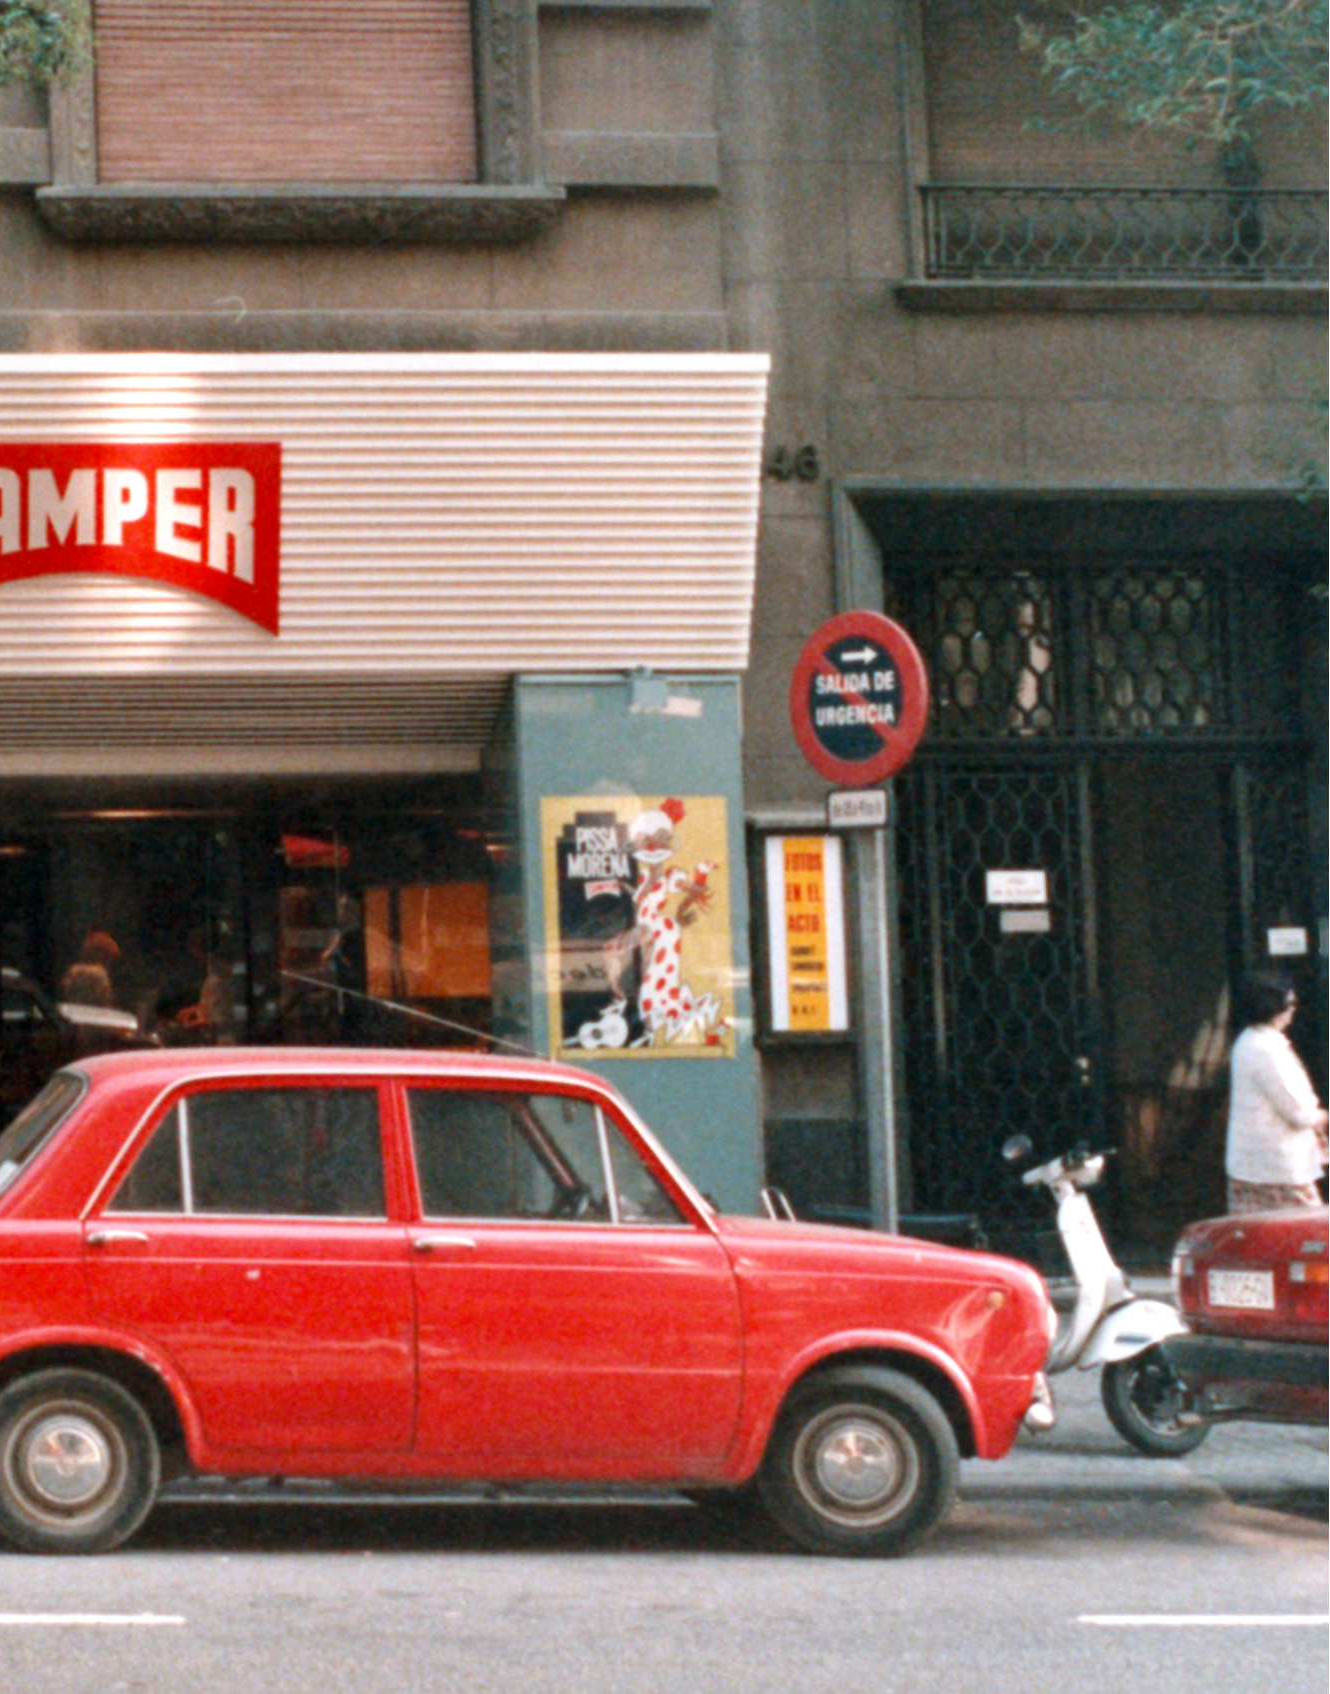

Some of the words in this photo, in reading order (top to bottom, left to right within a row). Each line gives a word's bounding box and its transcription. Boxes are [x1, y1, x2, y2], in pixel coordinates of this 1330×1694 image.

[815, 671, 870, 695] SALIDA
[873, 669, 896, 691] DE
[815, 702, 896, 727] URGENCIA
[575, 825, 620, 851] PISSA
[567, 850, 631, 878] MORENA
[784, 853, 823, 871] FOTOS
[785, 882, 801, 902] EN
[807, 882, 821, 902] EL
[787, 913, 820, 933] ACTO
